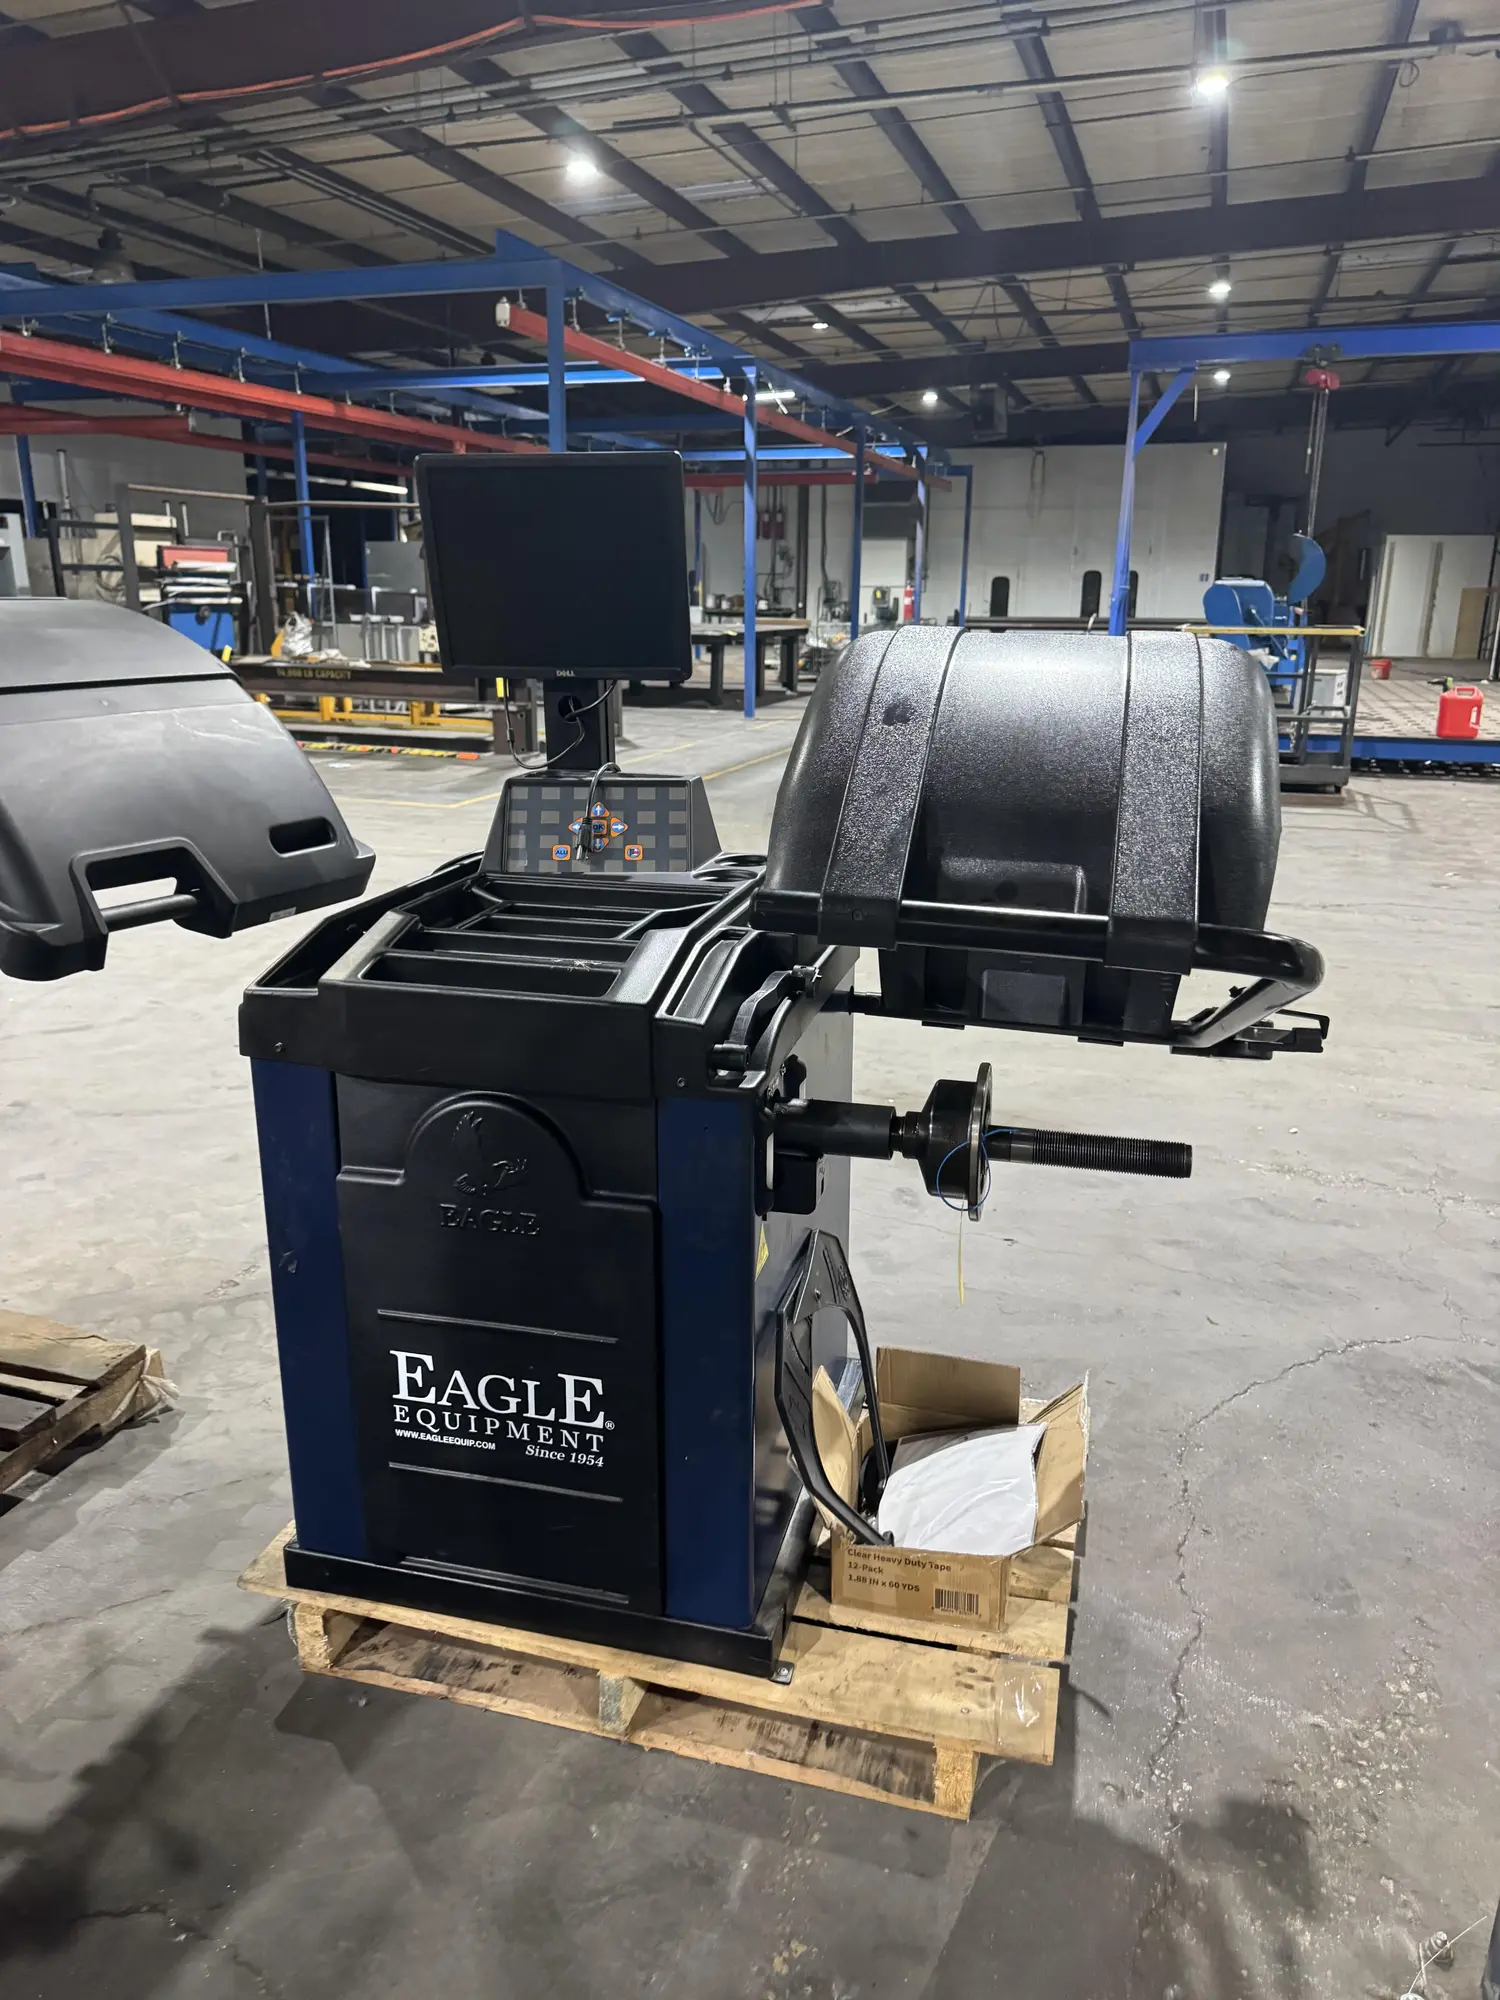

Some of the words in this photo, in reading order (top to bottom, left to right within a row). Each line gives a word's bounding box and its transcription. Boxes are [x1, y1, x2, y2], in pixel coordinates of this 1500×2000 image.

[440, 1203, 540, 1236] EAGLE
[393, 1404, 604, 1453] EQUIPMENT
[395, 1428, 496, 1451] WWW.EAGLEEQUIP.COM
[525, 1444, 565, 1461] Since
[569, 1452, 604, 1468] 1954
[847, 1549, 871, 1561] Clear
[873, 1553, 902, 1566] Heavy
[904, 1558, 926, 1570] Duty
[928, 1561, 952, 1573] Tape
[847, 1561, 884, 1575] 12-Pack
[848, 1574, 867, 1584] 1.88
[869, 1577, 879, 1587] IN
[888, 1581, 900, 1589] 60
[902, 1583, 920, 1593] YDS
